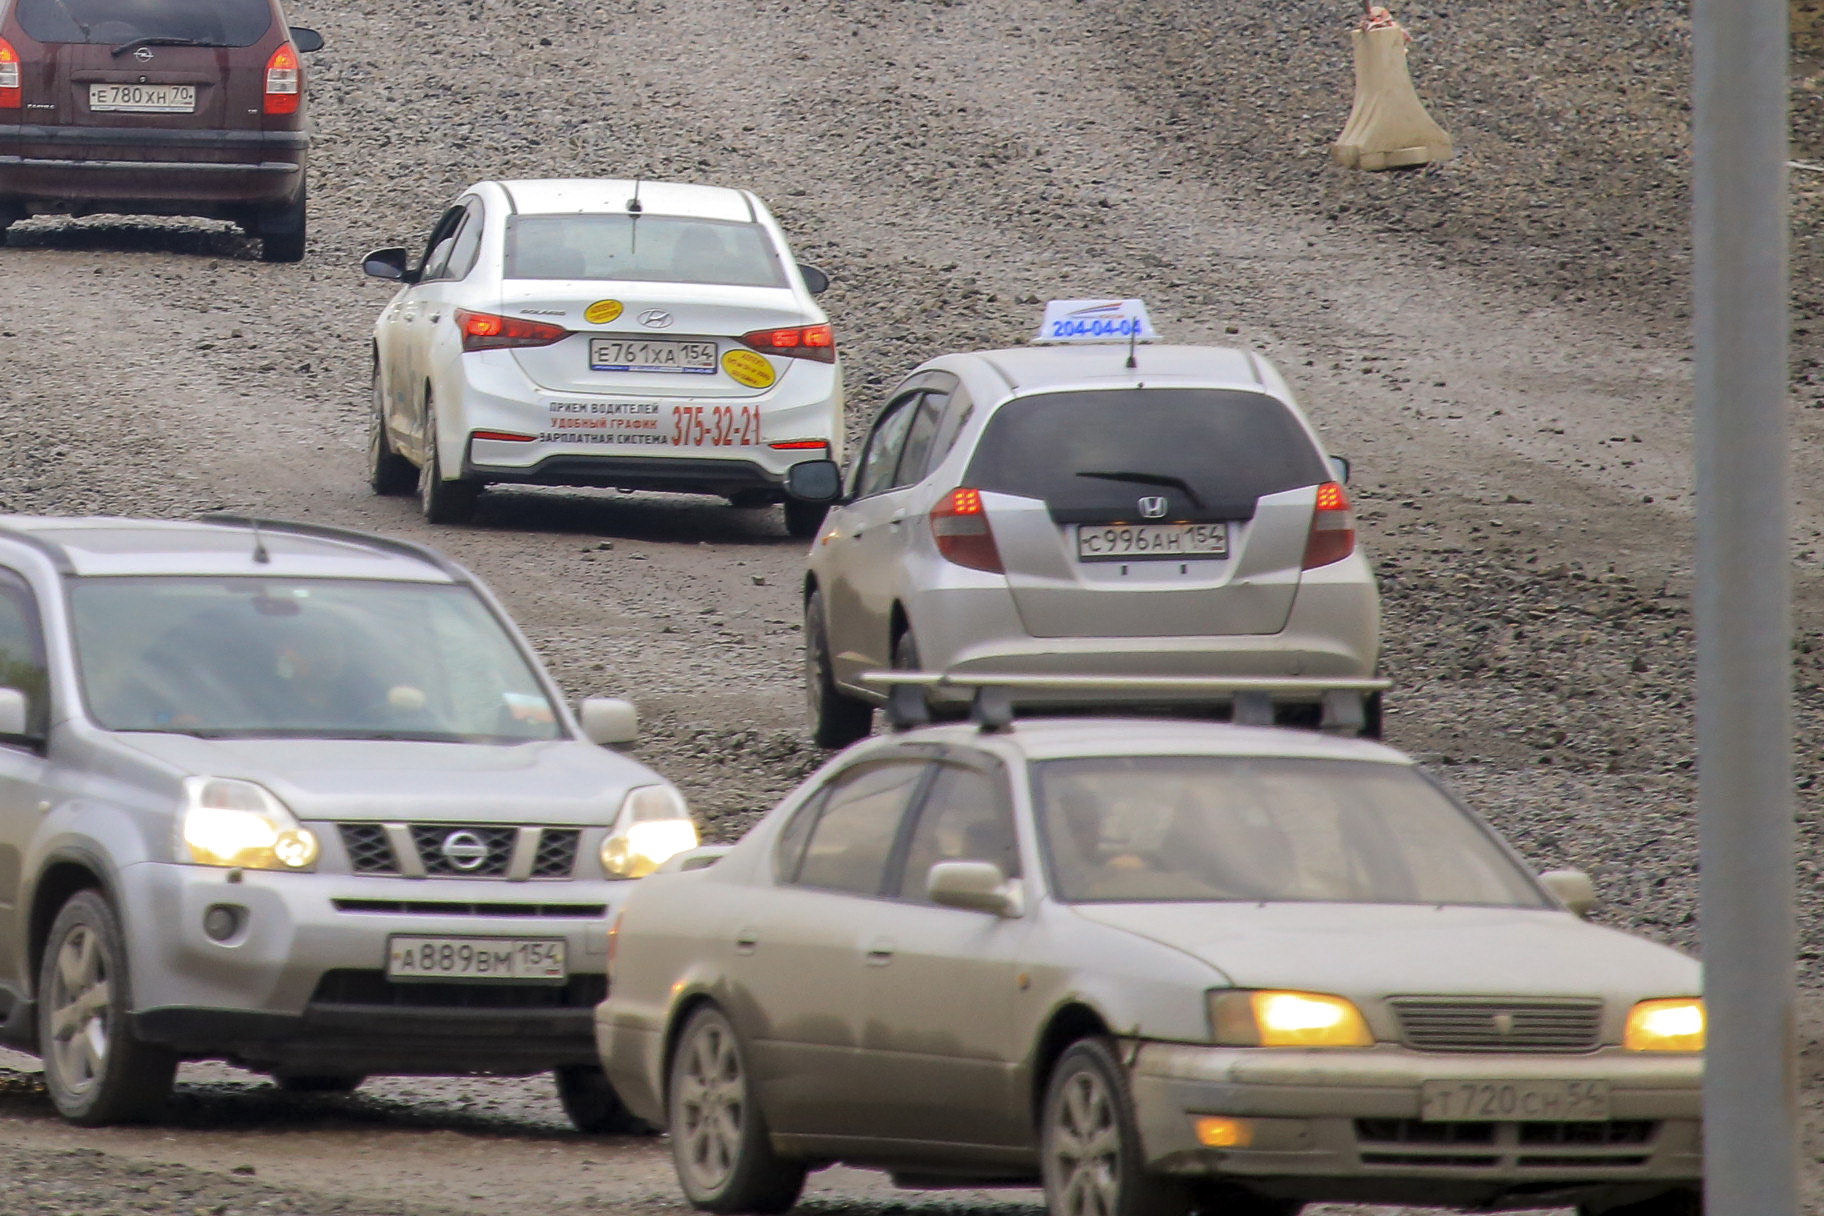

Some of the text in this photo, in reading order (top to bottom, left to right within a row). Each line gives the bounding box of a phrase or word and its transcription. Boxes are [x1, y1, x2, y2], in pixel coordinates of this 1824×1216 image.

[97, 87, 189, 104] Е780ХН 70
[1052, 319, 1143, 337] 204-04-04
[597, 343, 711, 364] Е761ХА 154
[549, 402, 659, 415] ПРИЕМ ВОДИТЕЛЕЙ
[550, 417, 658, 430] УДОБНЫЙ ГРАФИК
[672, 405, 762, 447] 375-32-21
[539, 432, 668, 445] ЗАРПЛАТНАЯ СИСТЕМА
[1088, 525, 1223, 551] С996АН 154
[401, 943, 559, 972] А889ВМ 154
